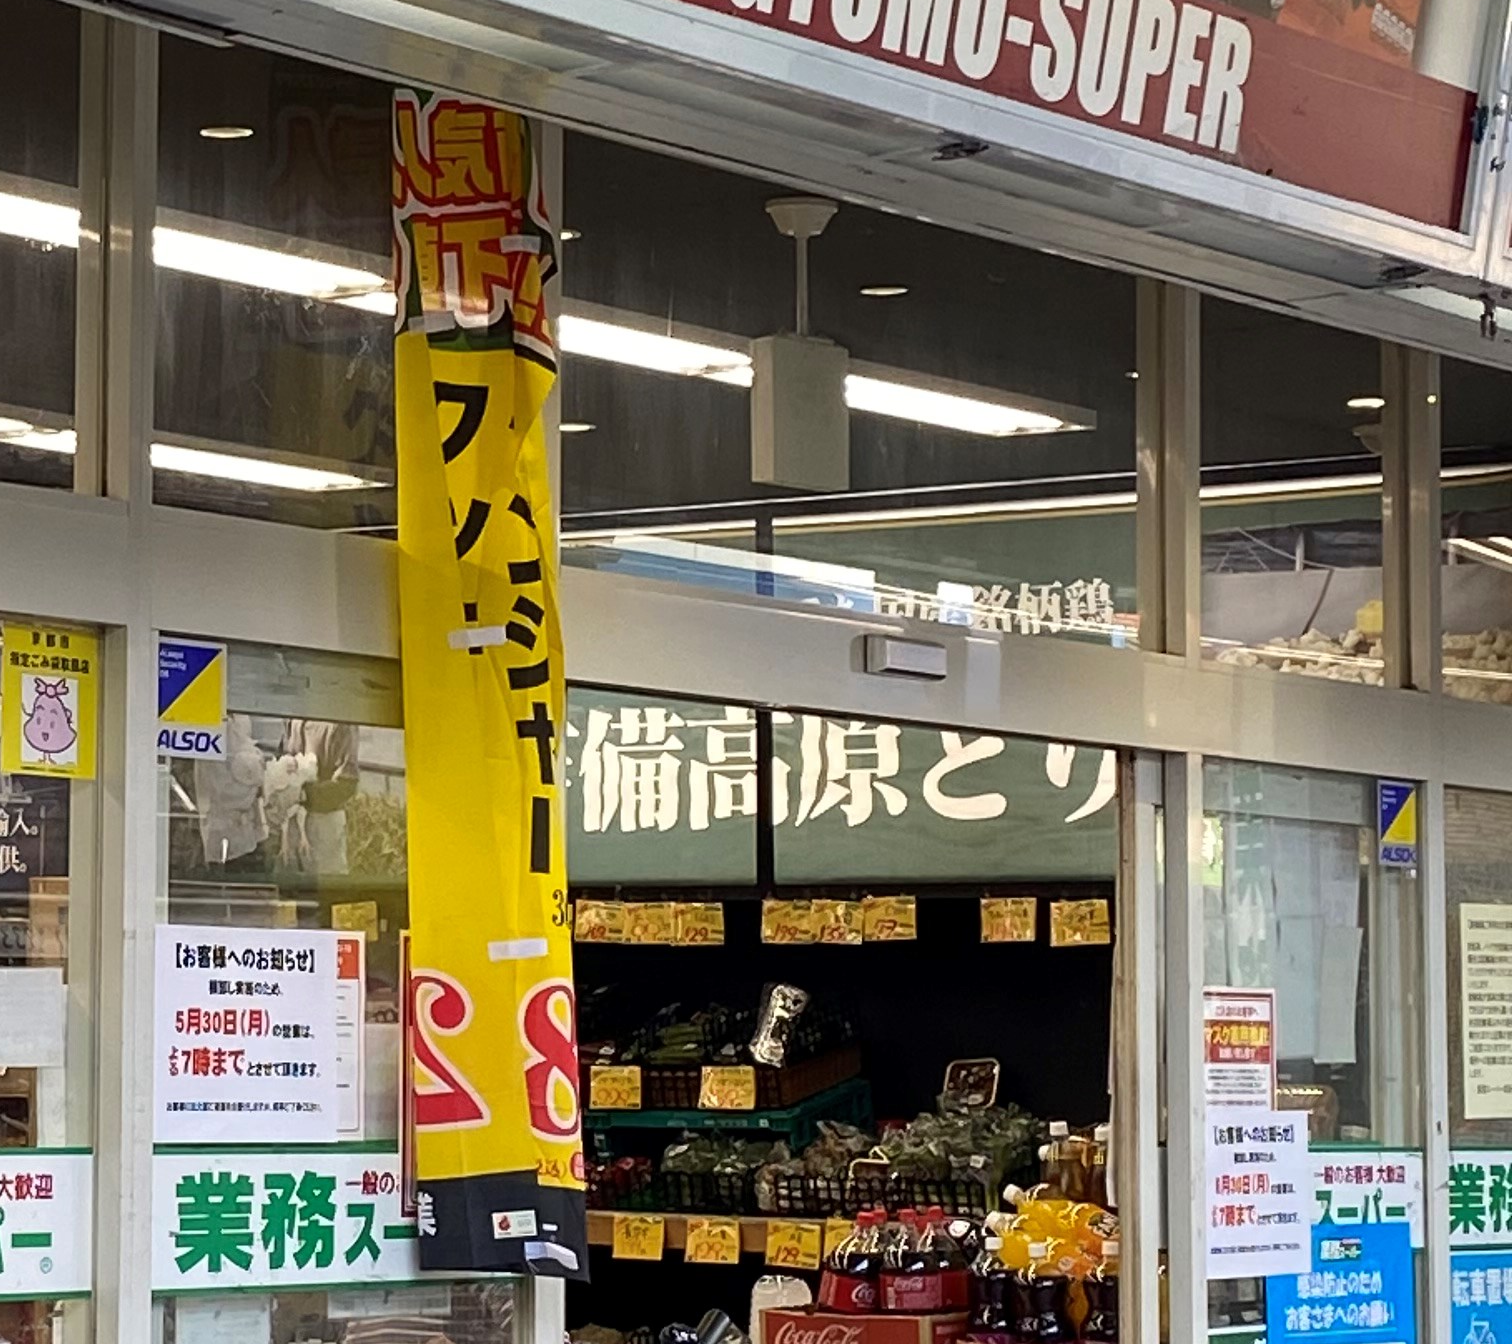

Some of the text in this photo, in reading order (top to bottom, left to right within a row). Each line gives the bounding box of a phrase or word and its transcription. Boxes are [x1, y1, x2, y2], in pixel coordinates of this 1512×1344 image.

[156, 730, 223, 755] ALSOK
[567, 706, 1116, 834] 備高原とり
[172, 1169, 420, 1275] 業務スー
